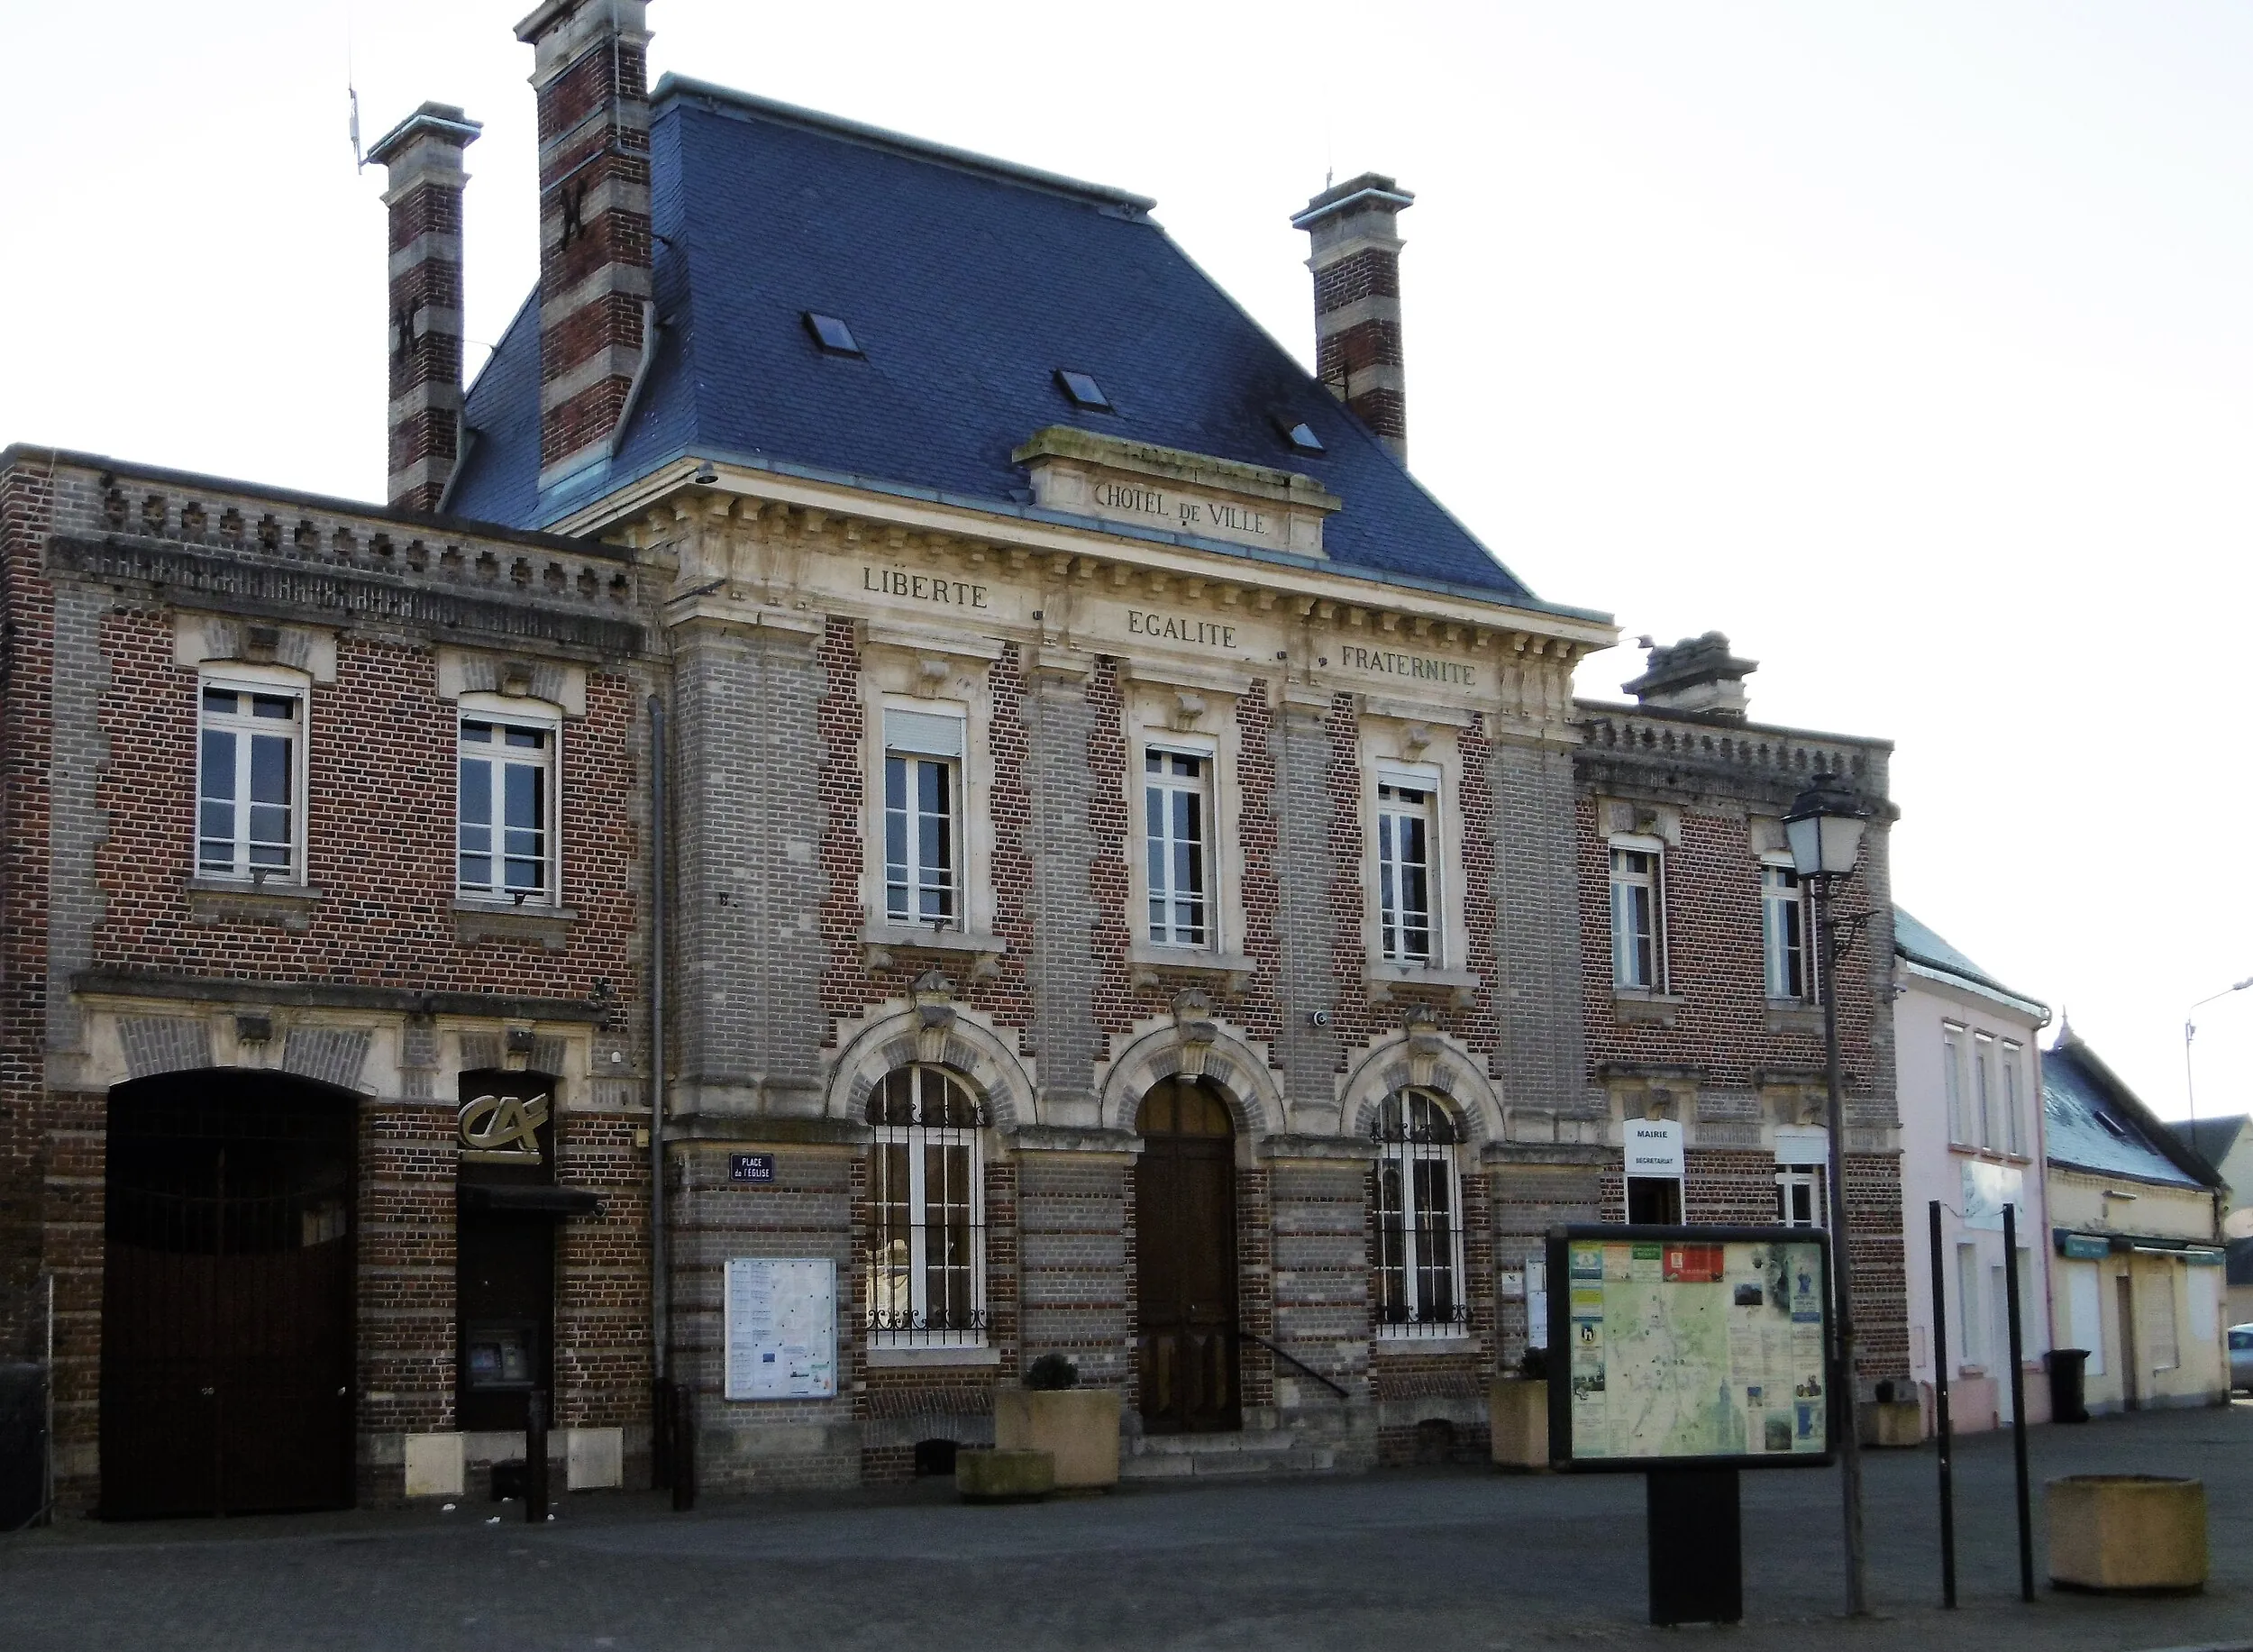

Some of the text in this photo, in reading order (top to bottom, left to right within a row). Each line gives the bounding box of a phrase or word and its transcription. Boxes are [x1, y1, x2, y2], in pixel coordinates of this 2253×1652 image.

[1179, 502, 1200, 522] DE
[1208, 503, 1266, 534] VILLE
[863, 567, 988, 608] LIBERTE
[1127, 609, 1236, 649] EGALITE
[1341, 645, 1476, 686] FRATERNITE
[1637, 1130, 1668, 1138] MAIRIE
[734, 1168, 743, 1177] de
[742, 1157, 762, 1167] PLACE
